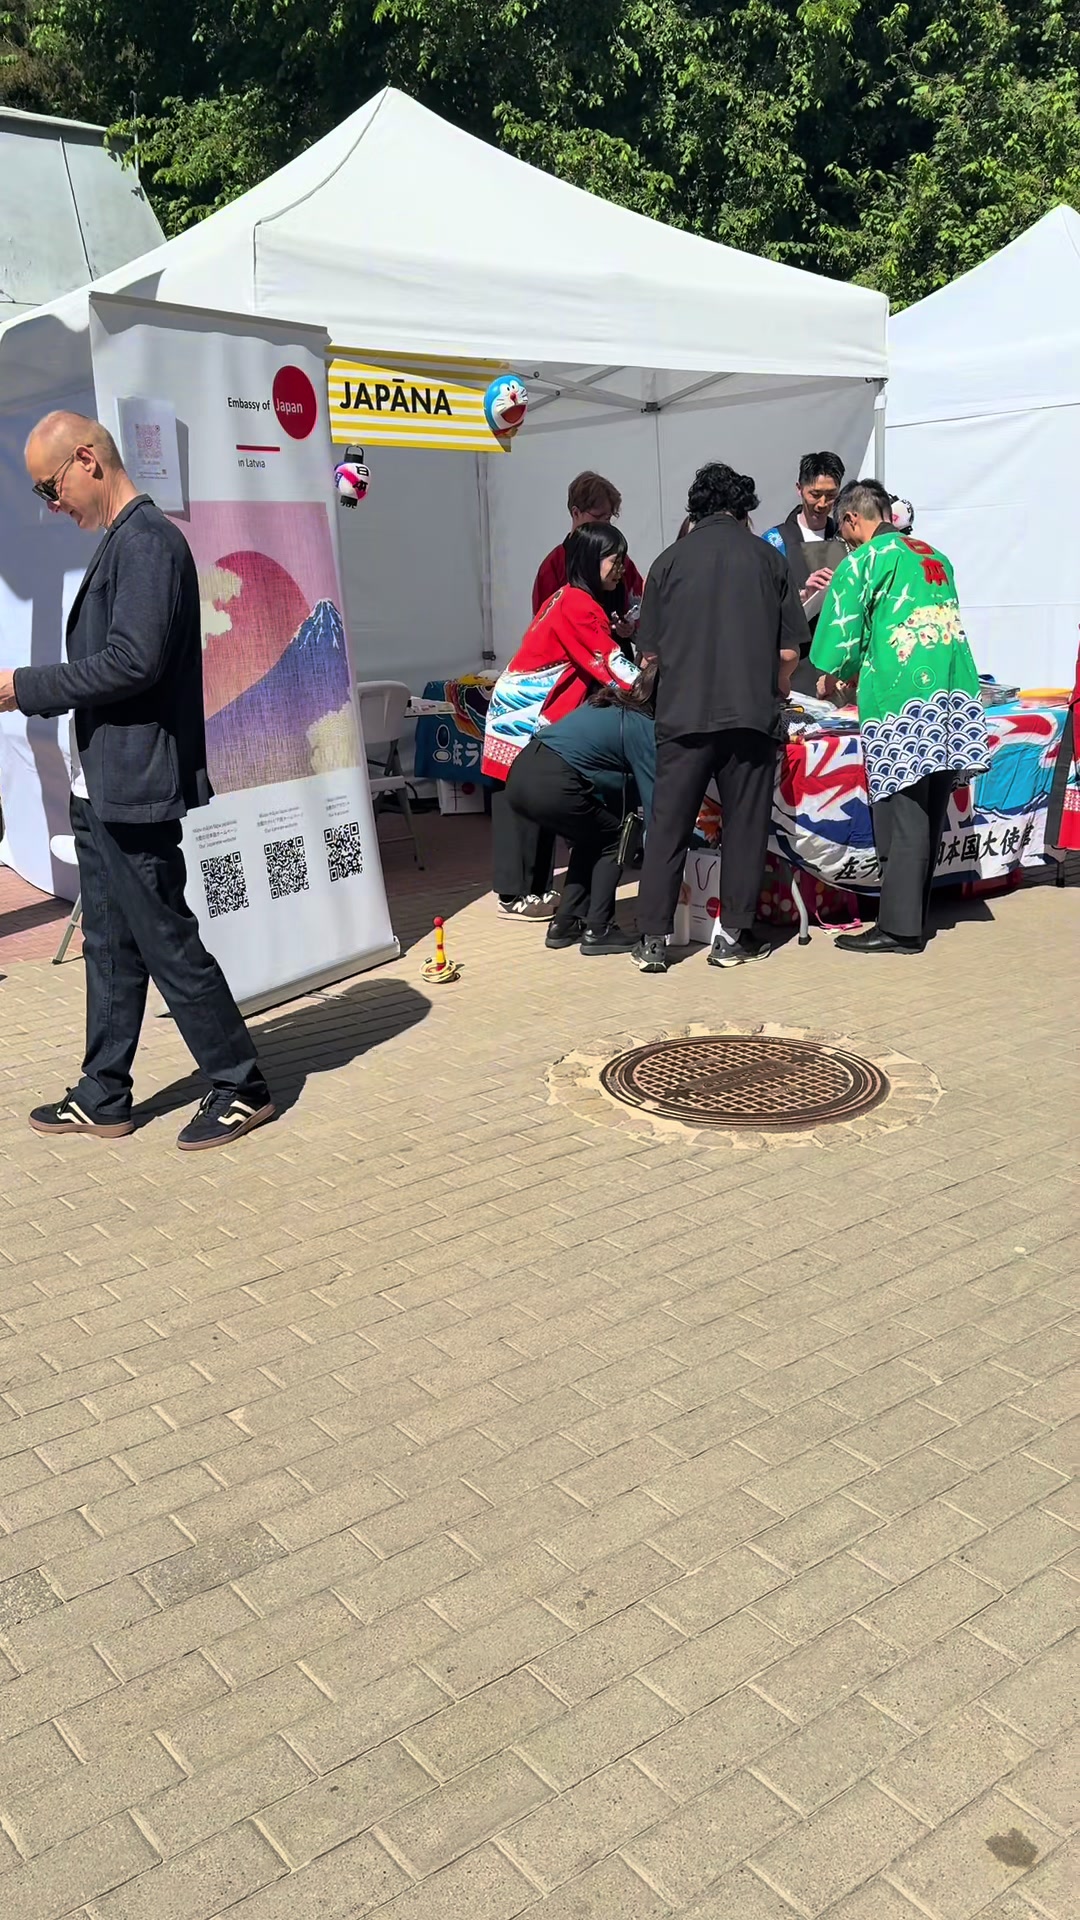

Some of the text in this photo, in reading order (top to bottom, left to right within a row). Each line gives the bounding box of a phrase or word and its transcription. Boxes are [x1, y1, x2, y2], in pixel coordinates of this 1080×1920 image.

[227, 397, 304, 416] Embassy of Japan
[339, 378, 453, 416] JAPĀNA
[238, 458, 266, 469] in Latvia
[452, 739, 483, 768] 在ラ
